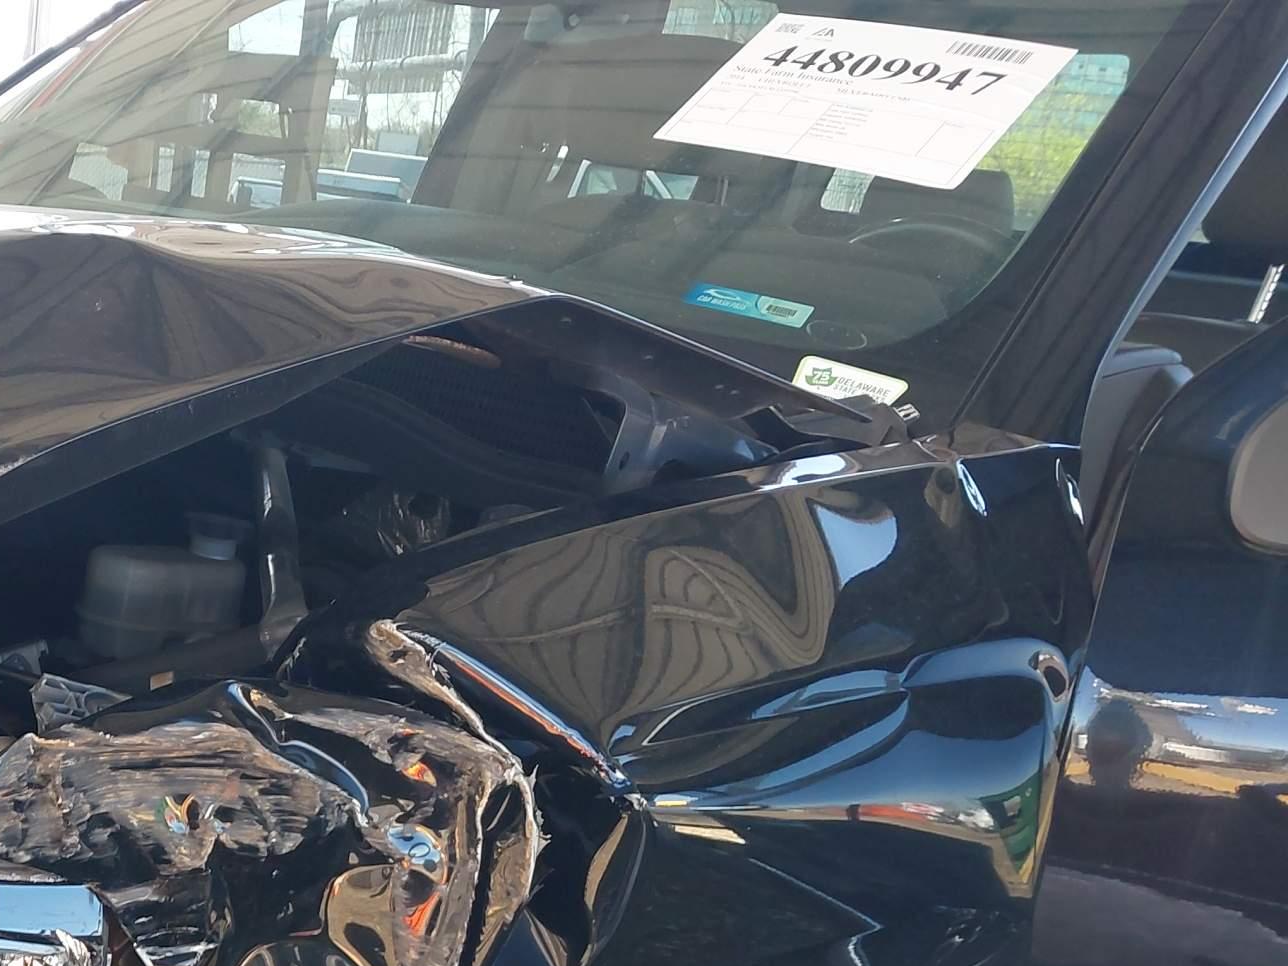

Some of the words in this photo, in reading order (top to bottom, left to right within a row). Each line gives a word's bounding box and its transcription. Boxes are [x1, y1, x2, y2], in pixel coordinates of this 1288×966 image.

[764, 45, 1007, 96] 44809947
[833, 383, 857, 395] STATE
[838, 376, 890, 397] DELAWARE
